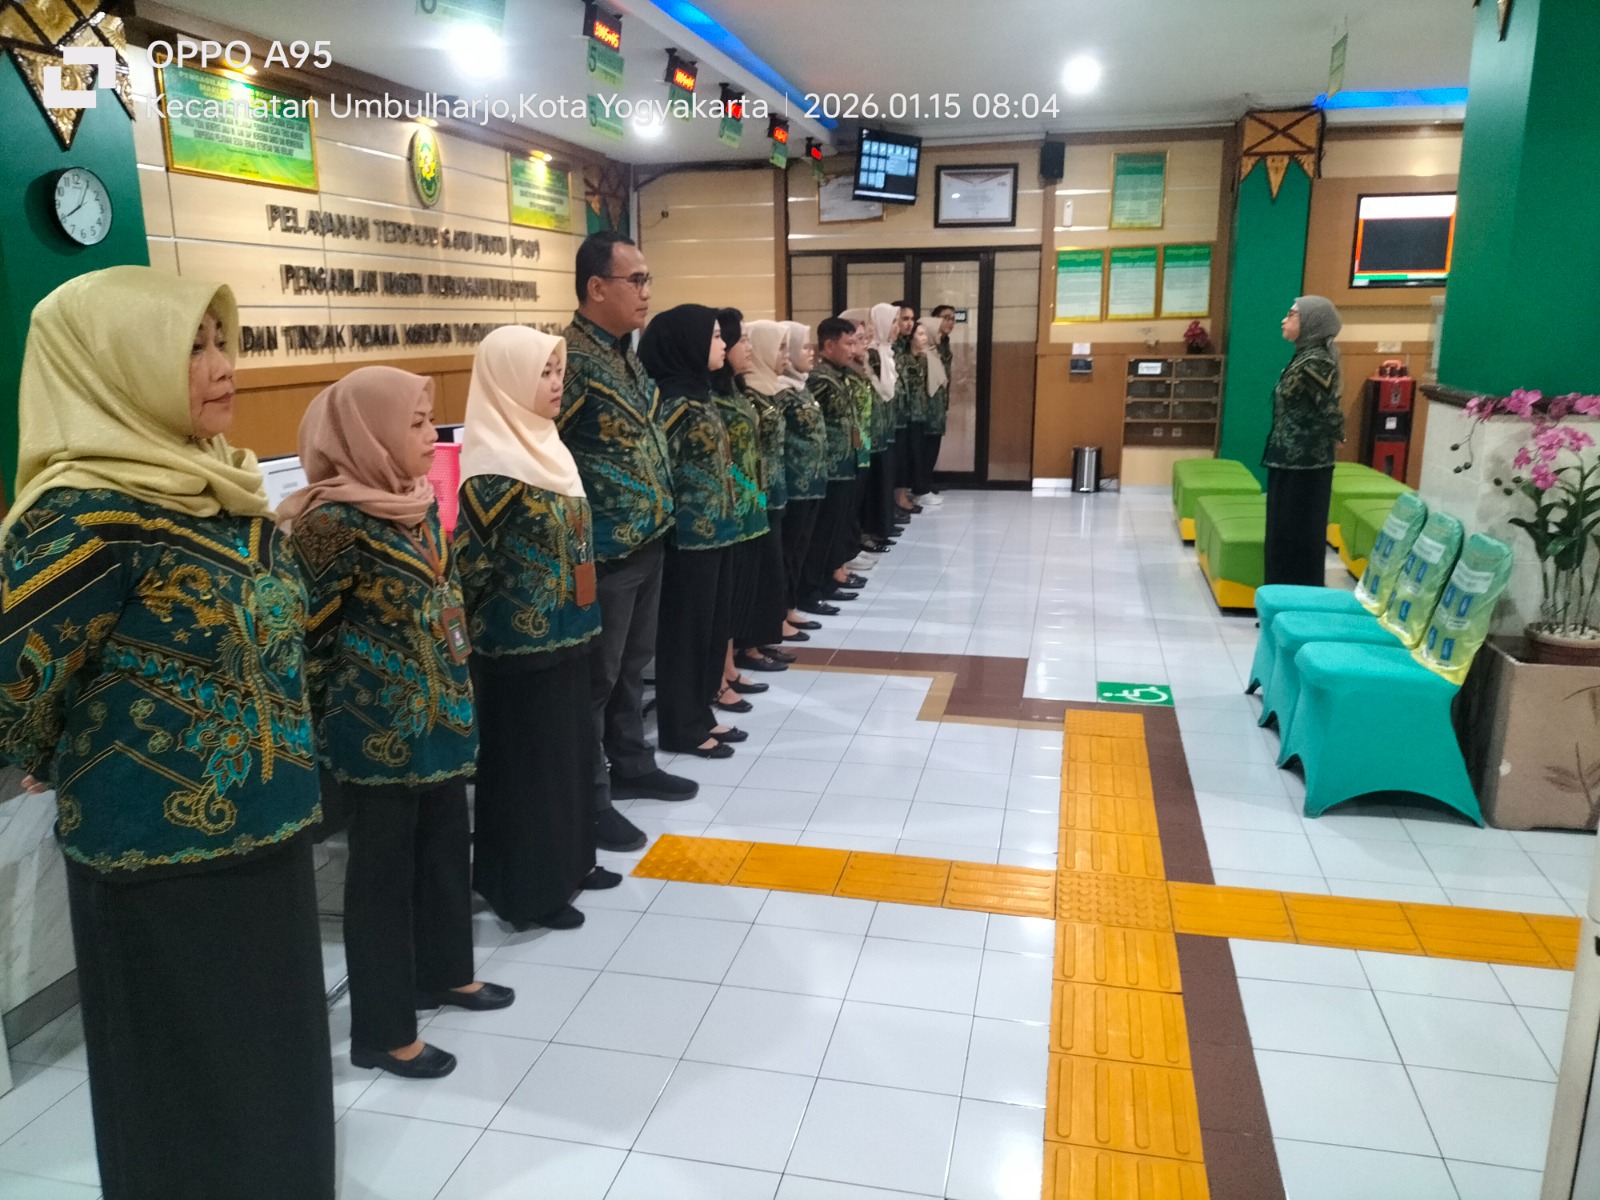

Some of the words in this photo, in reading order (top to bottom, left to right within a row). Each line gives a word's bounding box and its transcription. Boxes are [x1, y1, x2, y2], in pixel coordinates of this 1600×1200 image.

[71, 173, 81, 185] 12
[93, 190, 101, 201] 2
[70, 224, 76, 235] 7
[80, 229, 87, 239] 6
[90, 226, 96, 236] 5
